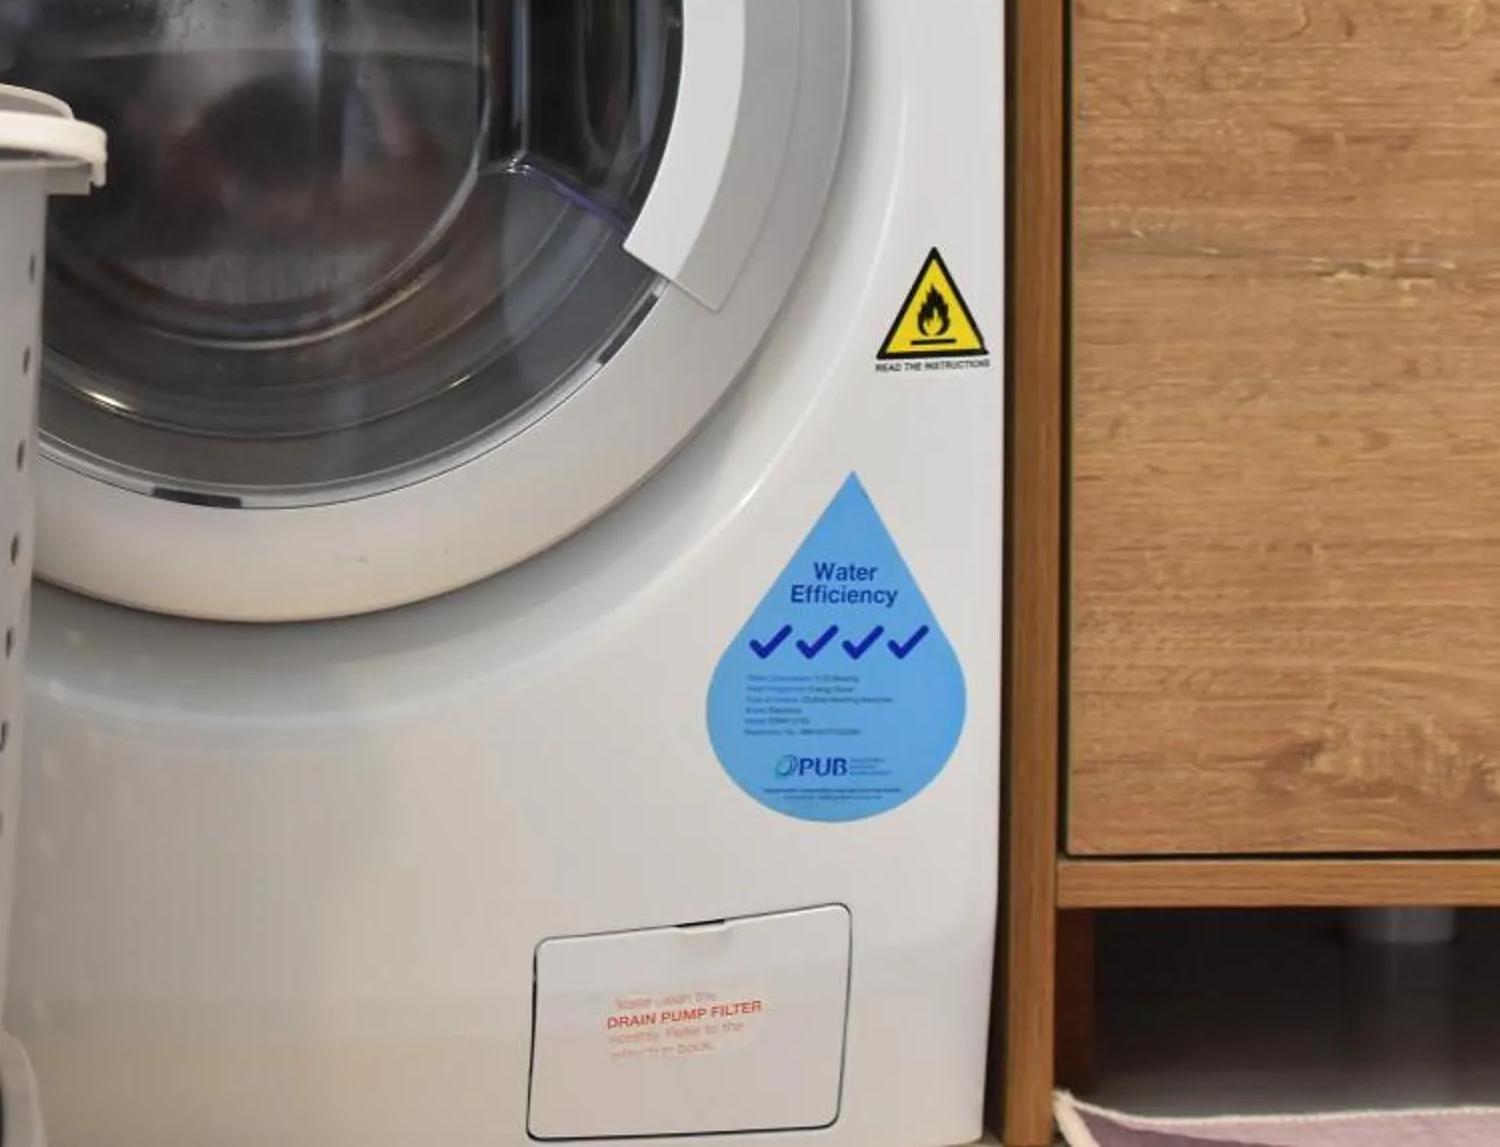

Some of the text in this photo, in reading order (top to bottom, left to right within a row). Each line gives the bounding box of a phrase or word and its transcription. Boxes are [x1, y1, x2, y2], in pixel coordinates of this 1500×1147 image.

[875, 362, 901, 372] READ
[905, 361, 922, 371] THE
[814, 562, 878, 582] Water
[791, 585, 898, 608] Efficiency
[799, 756, 848, 776] PUB
[607, 1000, 763, 1029] DRAIN PUMP FILTER
